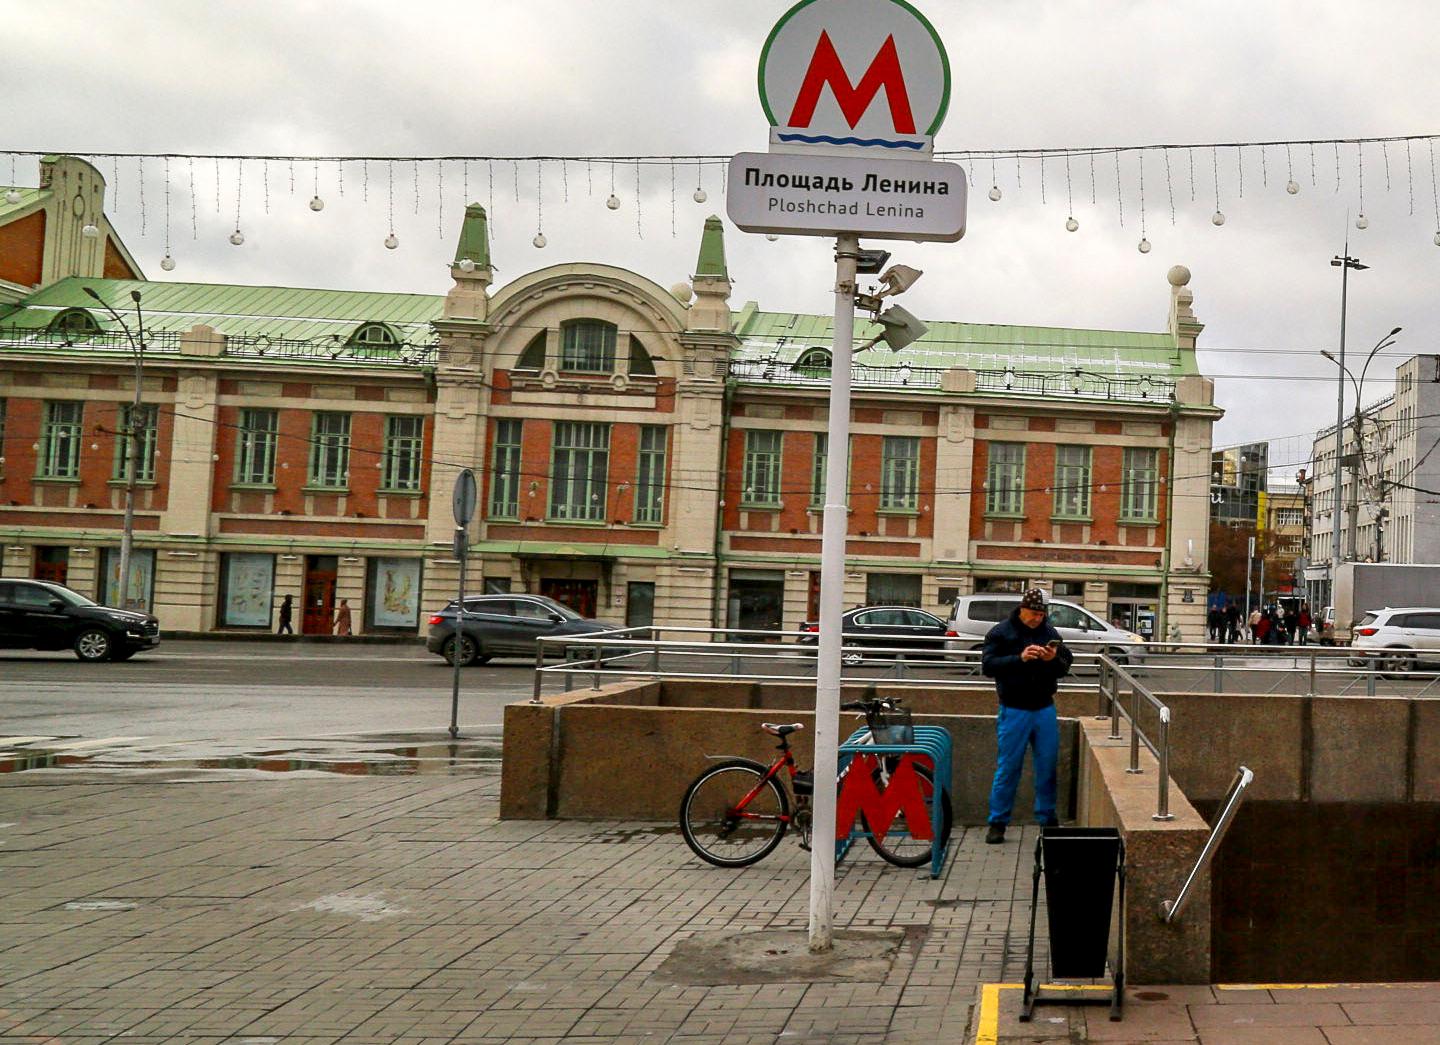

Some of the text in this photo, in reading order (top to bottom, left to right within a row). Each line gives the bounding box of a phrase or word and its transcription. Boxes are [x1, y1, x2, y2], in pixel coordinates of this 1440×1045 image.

[744, 167, 949, 195] Площадь Ленина
[768, 198, 924, 218] Ploshchad Lenina
